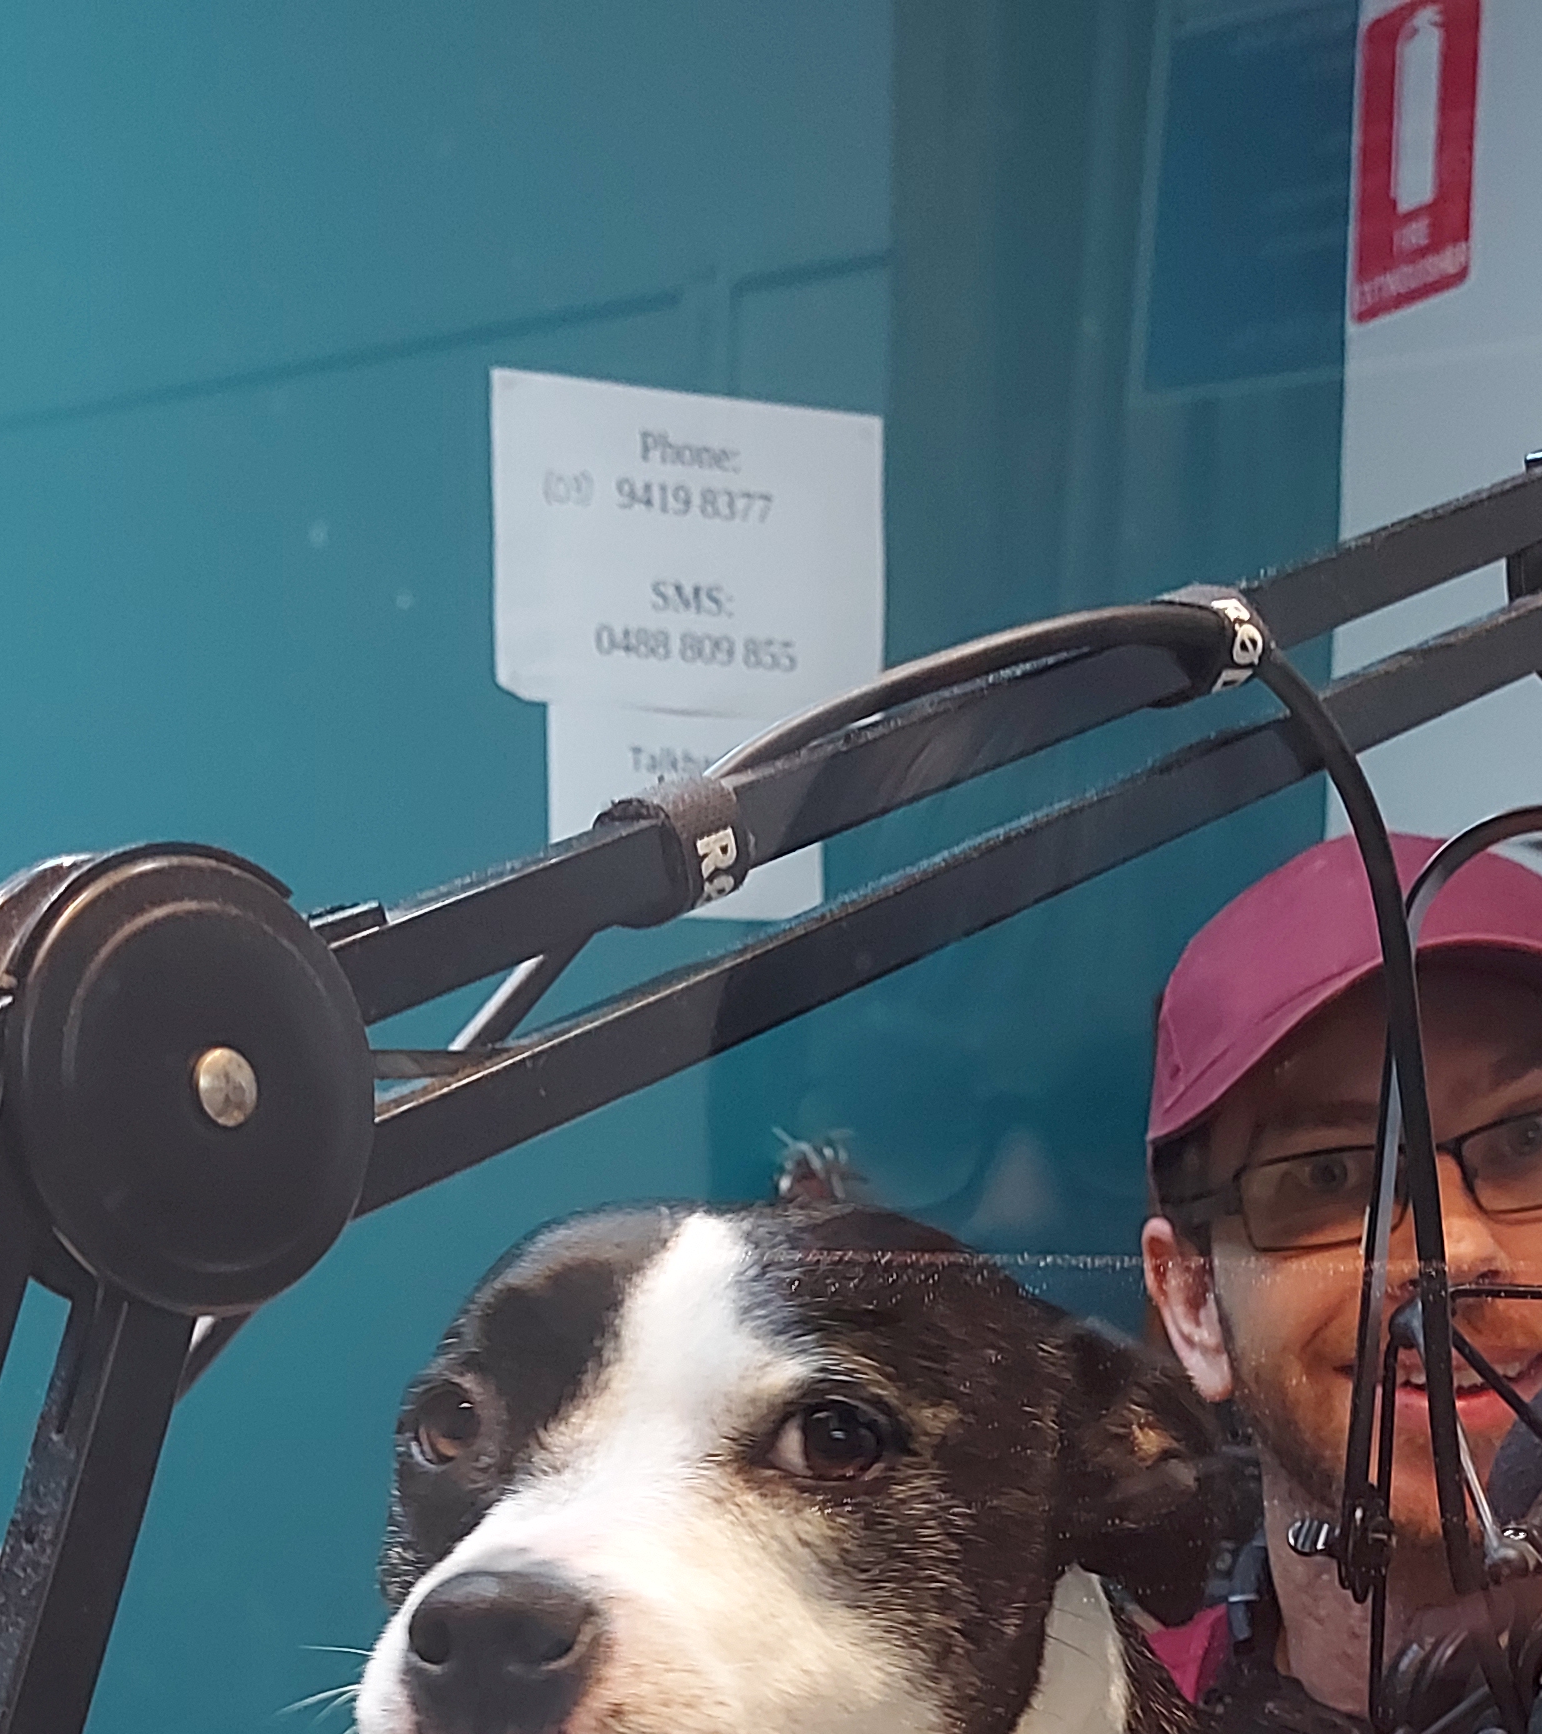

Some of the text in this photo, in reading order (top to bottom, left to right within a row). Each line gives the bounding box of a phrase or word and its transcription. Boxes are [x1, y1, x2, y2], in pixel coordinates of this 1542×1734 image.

[638, 429, 741, 474] Phone:
[614, 477, 693, 517] 9419
[651, 580, 734, 619] SMS:
[595, 624, 797, 673] 0488 809 855
